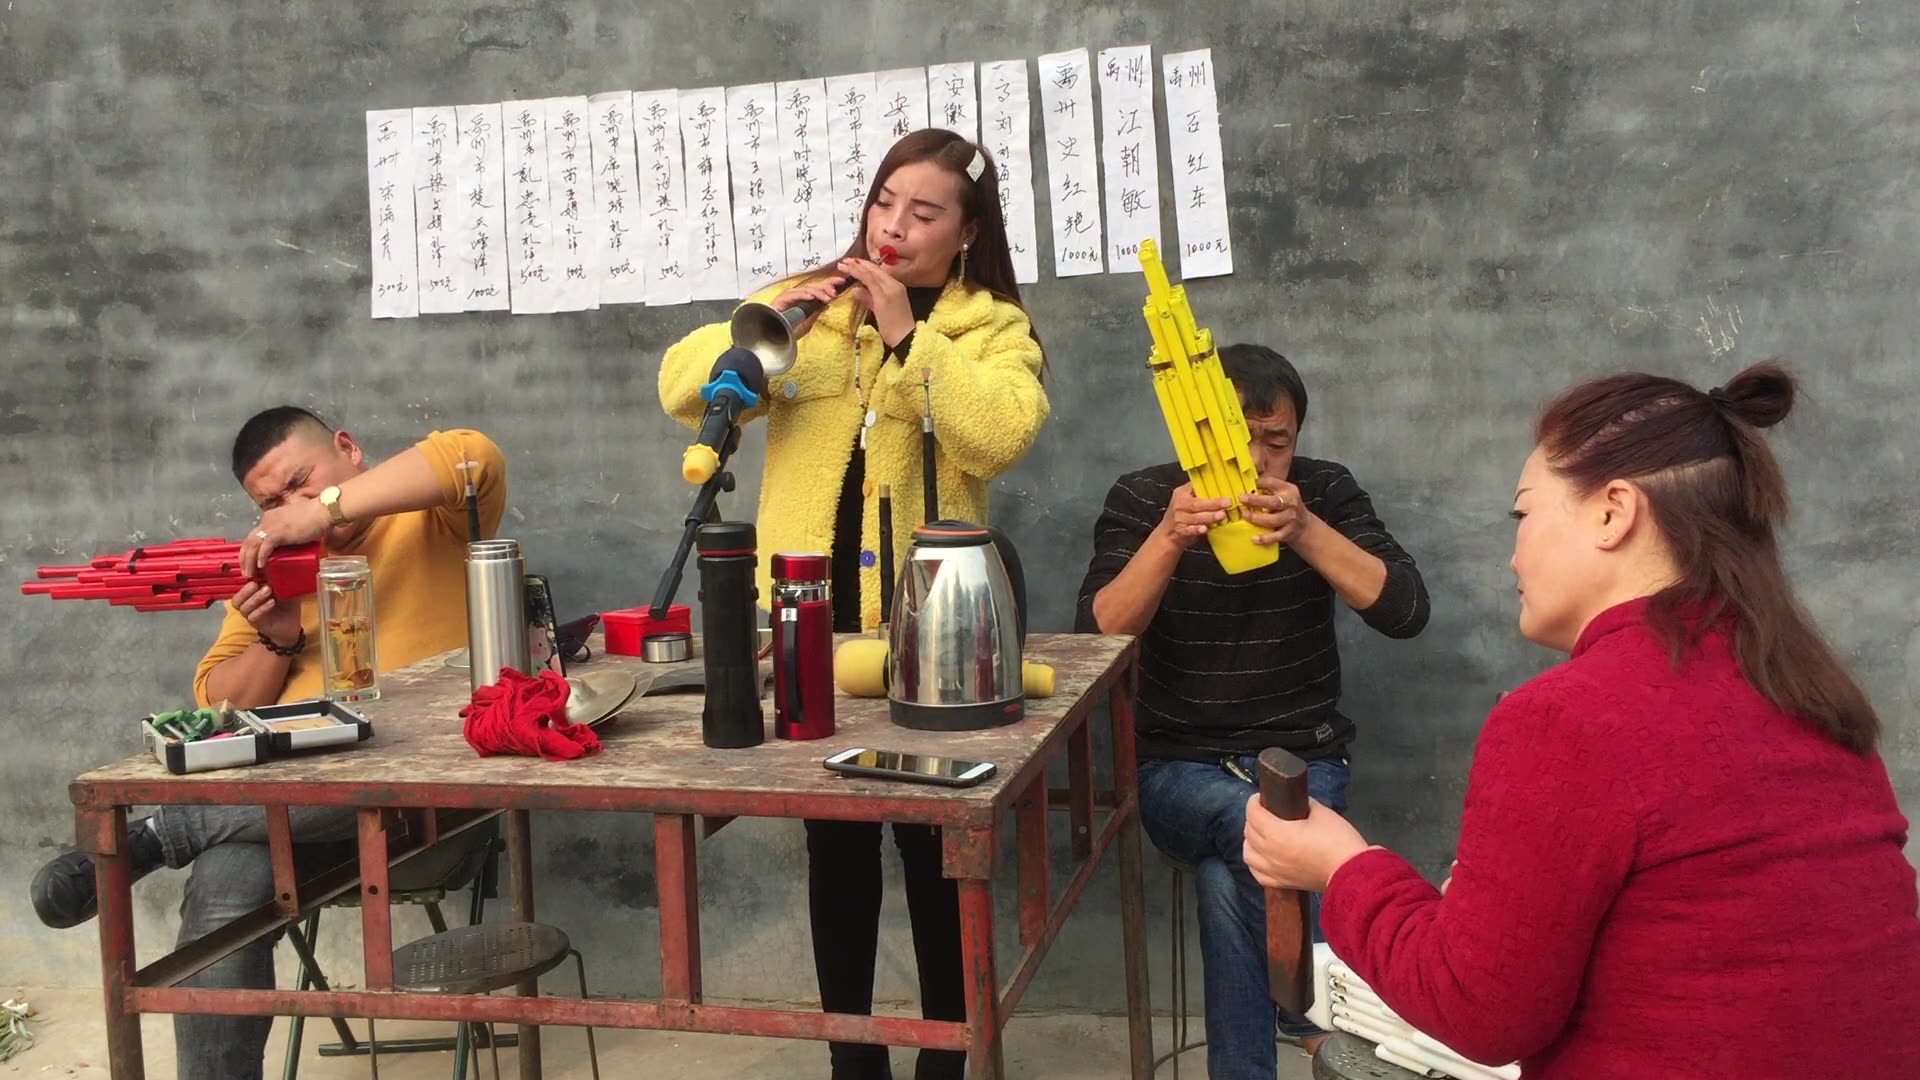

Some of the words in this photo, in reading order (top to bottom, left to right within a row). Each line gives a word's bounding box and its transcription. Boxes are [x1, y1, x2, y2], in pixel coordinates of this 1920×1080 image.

[944, 73, 968, 127] 安徽
[1060, 245, 1099, 262] 1000元
[1186, 238, 1229, 259] 1000元
